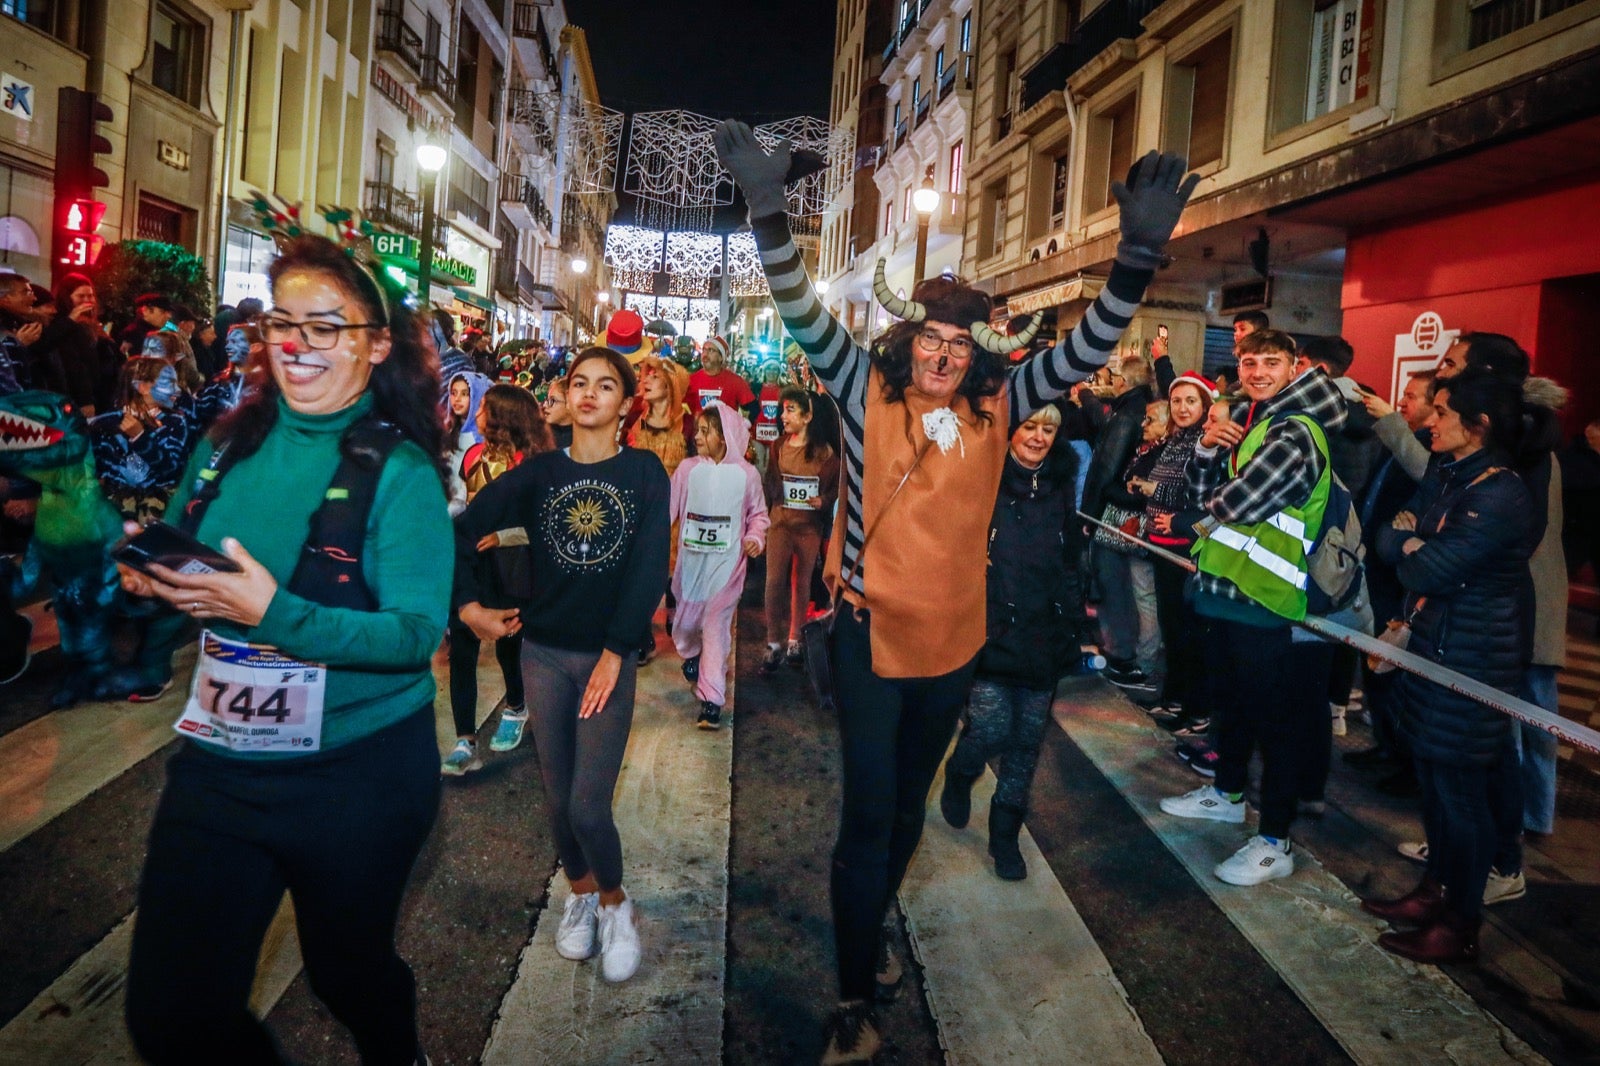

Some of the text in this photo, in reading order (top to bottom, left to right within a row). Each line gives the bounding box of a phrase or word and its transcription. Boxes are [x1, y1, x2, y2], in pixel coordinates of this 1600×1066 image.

[1343, 10, 1357, 32] B1
[1341, 37, 1354, 59] B2
[1340, 64, 1352, 85] C1
[416, 239, 477, 285] FRMACIA
[789, 487, 808, 500] 89
[698, 527, 718, 542] 75
[208, 677, 291, 723] 744
